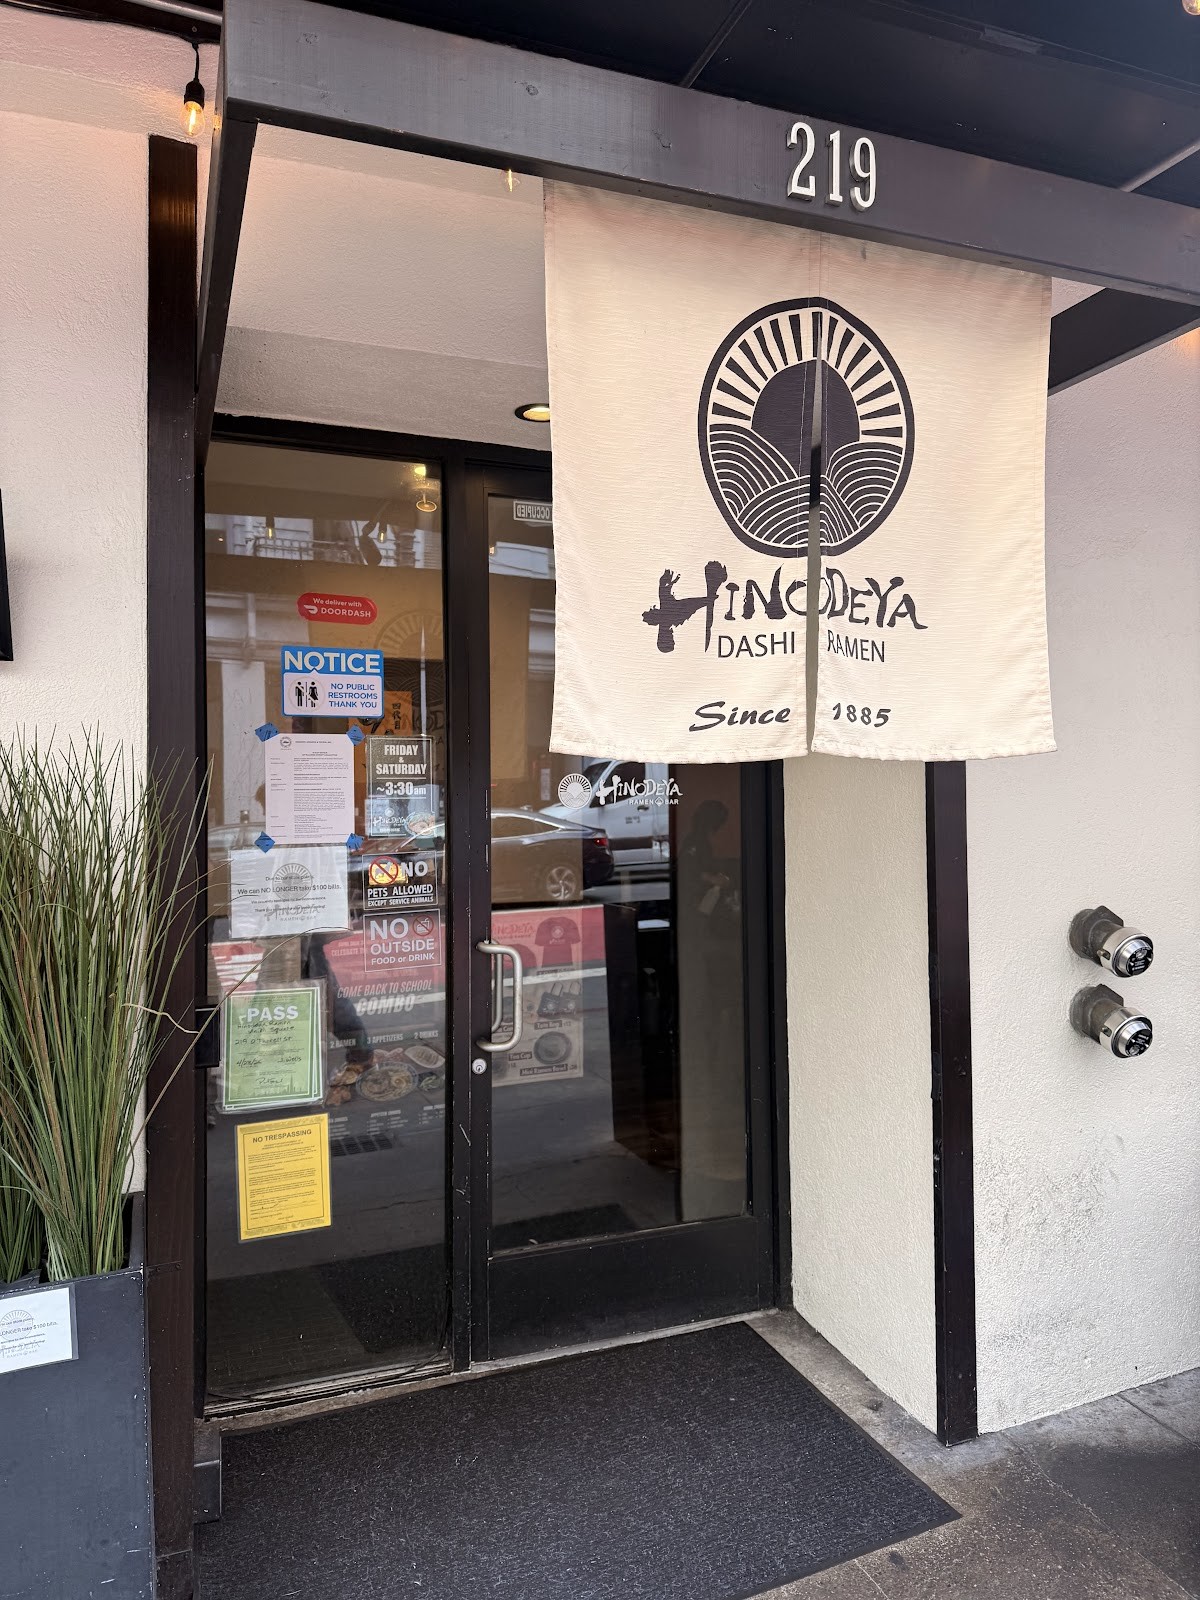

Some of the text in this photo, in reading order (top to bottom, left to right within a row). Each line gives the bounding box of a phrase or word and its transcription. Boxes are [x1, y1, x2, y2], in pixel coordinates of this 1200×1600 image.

[786, 121, 877, 211] 219
[325, 598, 347, 606] deliver
[641, 560, 929, 653] HINODEYA
[320, 607, 371, 618] DOORDASH
[717, 629, 886, 663] DASHI RAMEN
[284, 650, 381, 673] NOTICE
[330, 682, 375, 691] NO PUBLIC
[327, 691, 378, 700] RESTROOMS
[328, 700, 377, 709] THANK YOU
[688, 700, 892, 732] Since 1885
[384, 744, 419, 756] FRIDAY
[375, 763, 427, 775] SATURDAY
[595, 774, 683, 806] HINODEYA
[401, 860, 429, 878] NO
[272, 885, 298, 893] LONGER
[367, 883, 433, 898] PETS ALLOWED
[367, 896, 434, 907] EXCEPT SERVICE ANIMALS
[369, 917, 409, 940] NO
[370, 938, 435, 955] OUTSIDE
[371, 952, 435, 965] FOOD or DRINK
[337, 979, 433, 999] COME BACK TO SCHOOL
[247, 1005, 299, 1022] PASS
[356, 993, 416, 1017] COMBO
[329, 1041, 335, 1049] 2
[335, 1038, 357, 1048] RAMEN
[372, 1033, 404, 1044] APPETIZERS
[413, 1032, 419, 1040] 2
[264, 1128, 312, 1142] TRESPASSING
